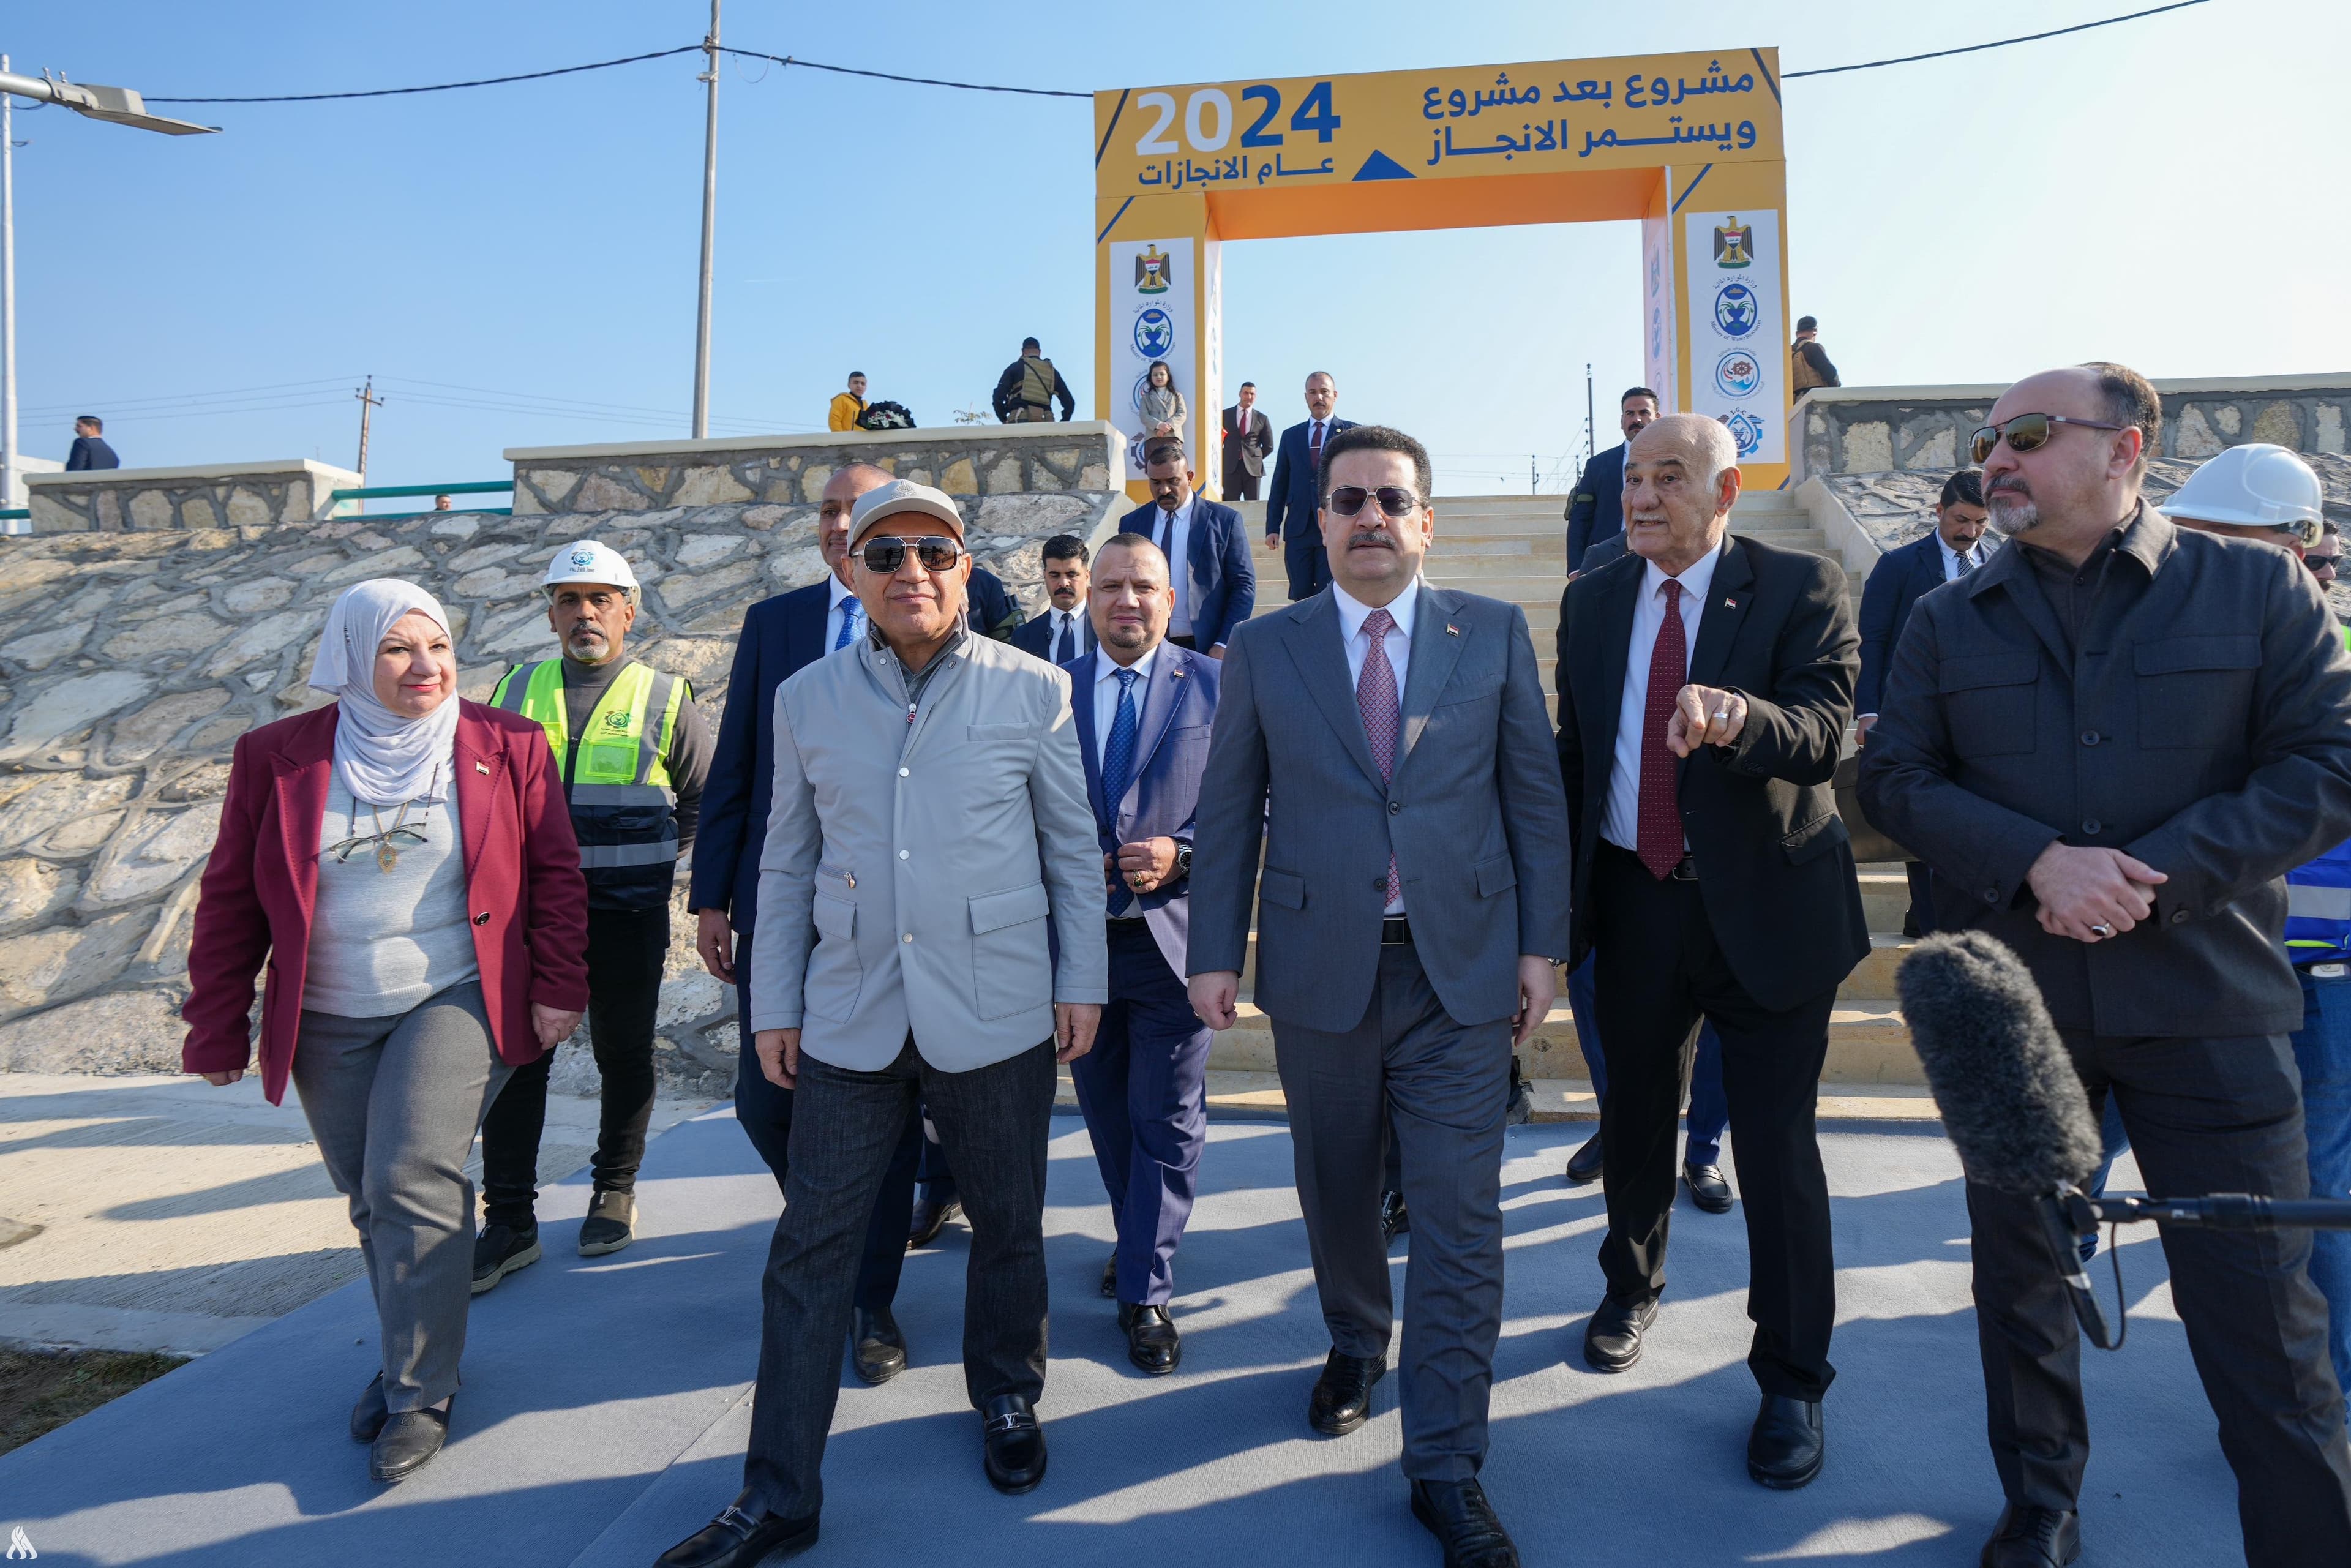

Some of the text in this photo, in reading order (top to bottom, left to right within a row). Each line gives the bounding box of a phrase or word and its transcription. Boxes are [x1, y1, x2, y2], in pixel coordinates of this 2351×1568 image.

[1422, 59, 1755, 120] مشروع بعد مشروع
[1135, 81, 1341, 156] 2024
[1427, 115, 1757, 166] ويستمر الانجاز
[1138, 153, 1334, 189] عام الانجازات
